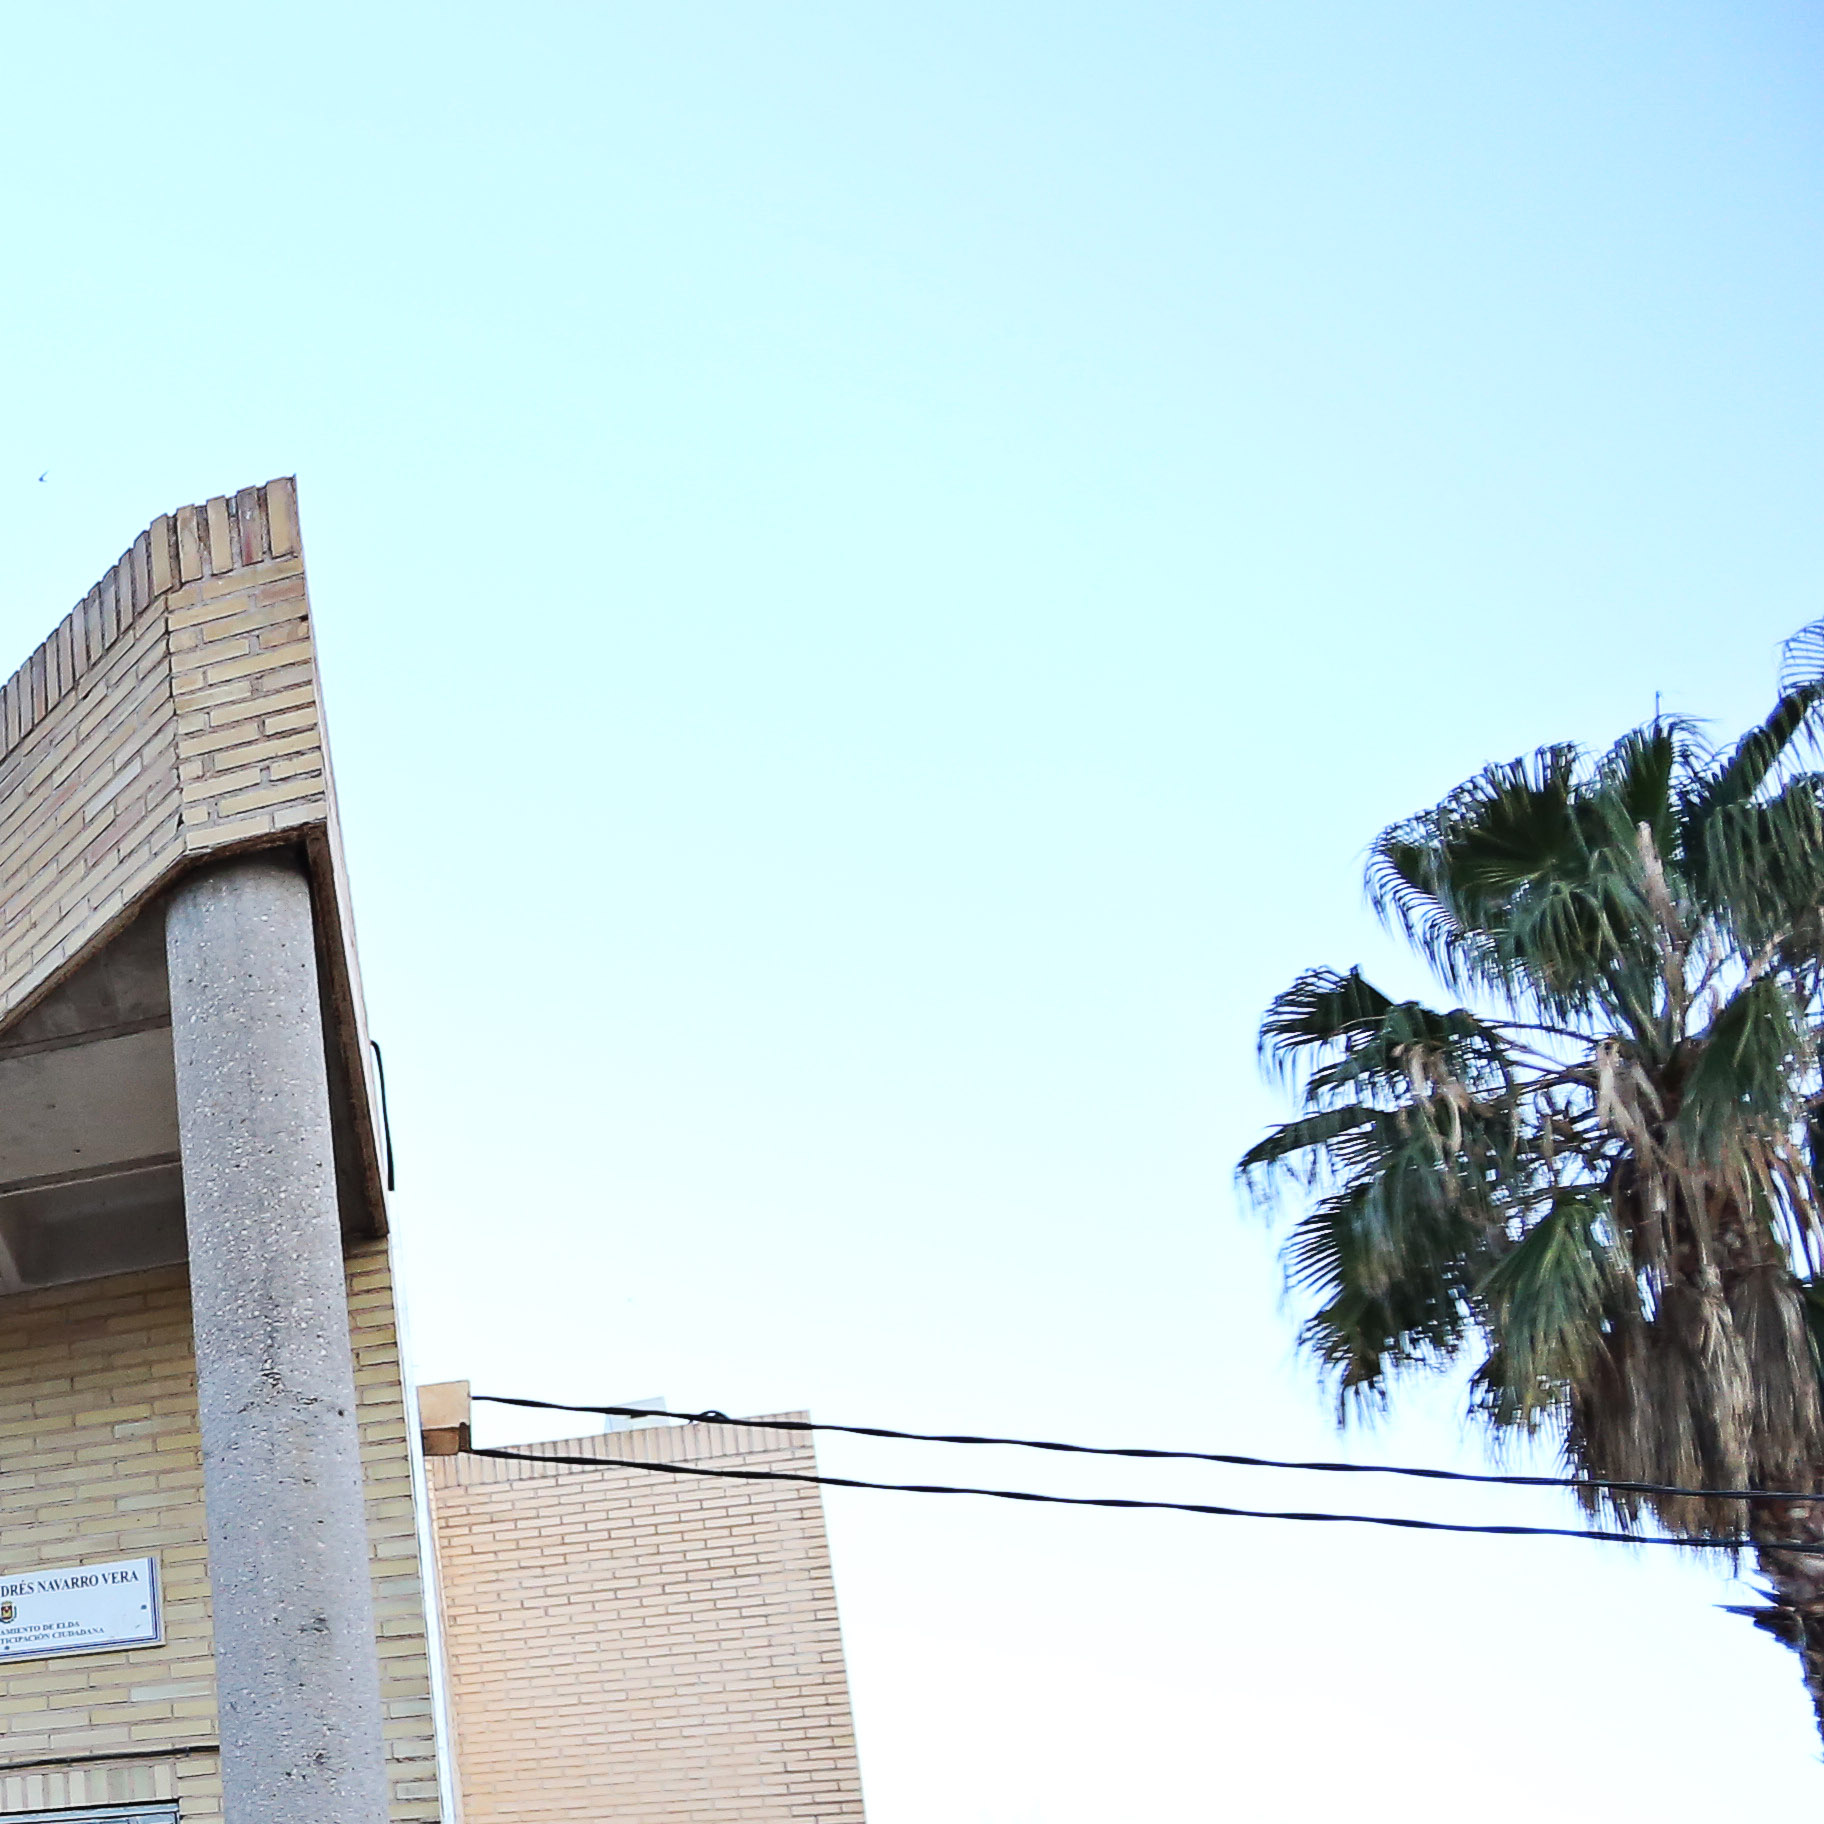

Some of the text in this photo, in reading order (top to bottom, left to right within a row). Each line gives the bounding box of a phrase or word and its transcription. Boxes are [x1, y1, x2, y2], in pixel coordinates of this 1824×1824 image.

[38, 1574, 99, 1592] NAVARRO
[101, 1570, 139, 1585] VERA
[43, 1623, 54, 1631] DE
[56, 1621, 80, 1629] ELDA
[52, 1627, 104, 1639] CIUDADANA
